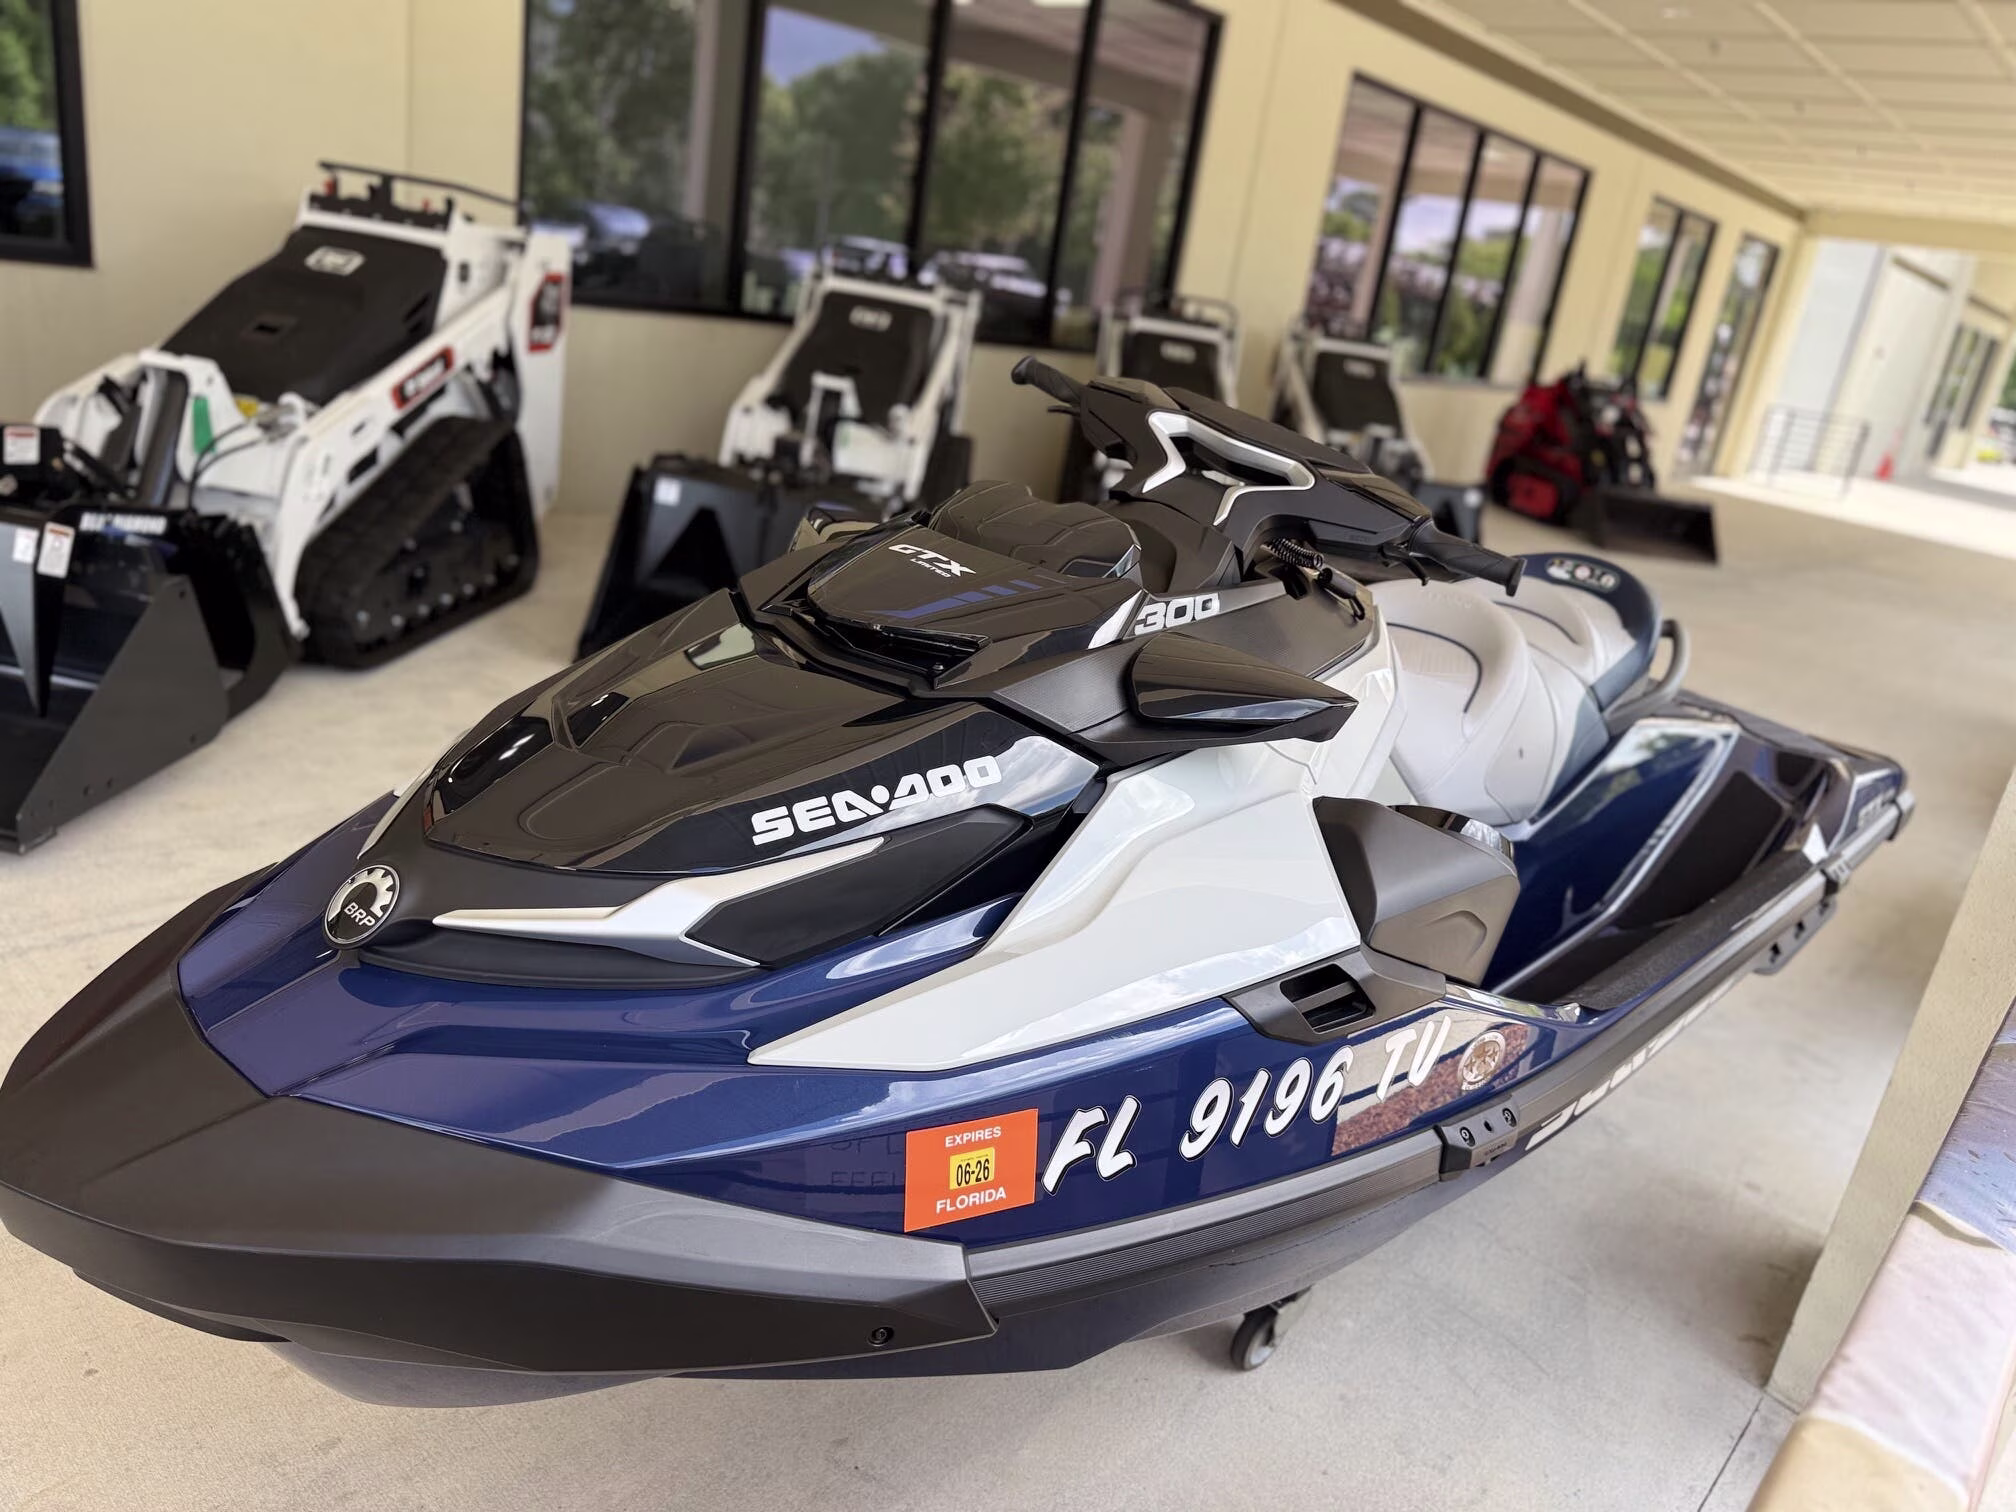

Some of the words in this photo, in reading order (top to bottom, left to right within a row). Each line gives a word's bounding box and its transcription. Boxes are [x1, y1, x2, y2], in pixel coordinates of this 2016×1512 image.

[889, 544, 976, 576] GTX
[1134, 592, 1219, 636] 300
[343, 901, 376, 926] BRP
[1040, 1094, 1141, 1195] FL
[1179, 1044, 1354, 1161] 9196
[1375, 1015, 1451, 1101] TU
[945, 1126, 1001, 1147] EXPIRES
[956, 1158, 990, 1187] 06-26
[936, 1186, 1006, 1213] FLORIDA
